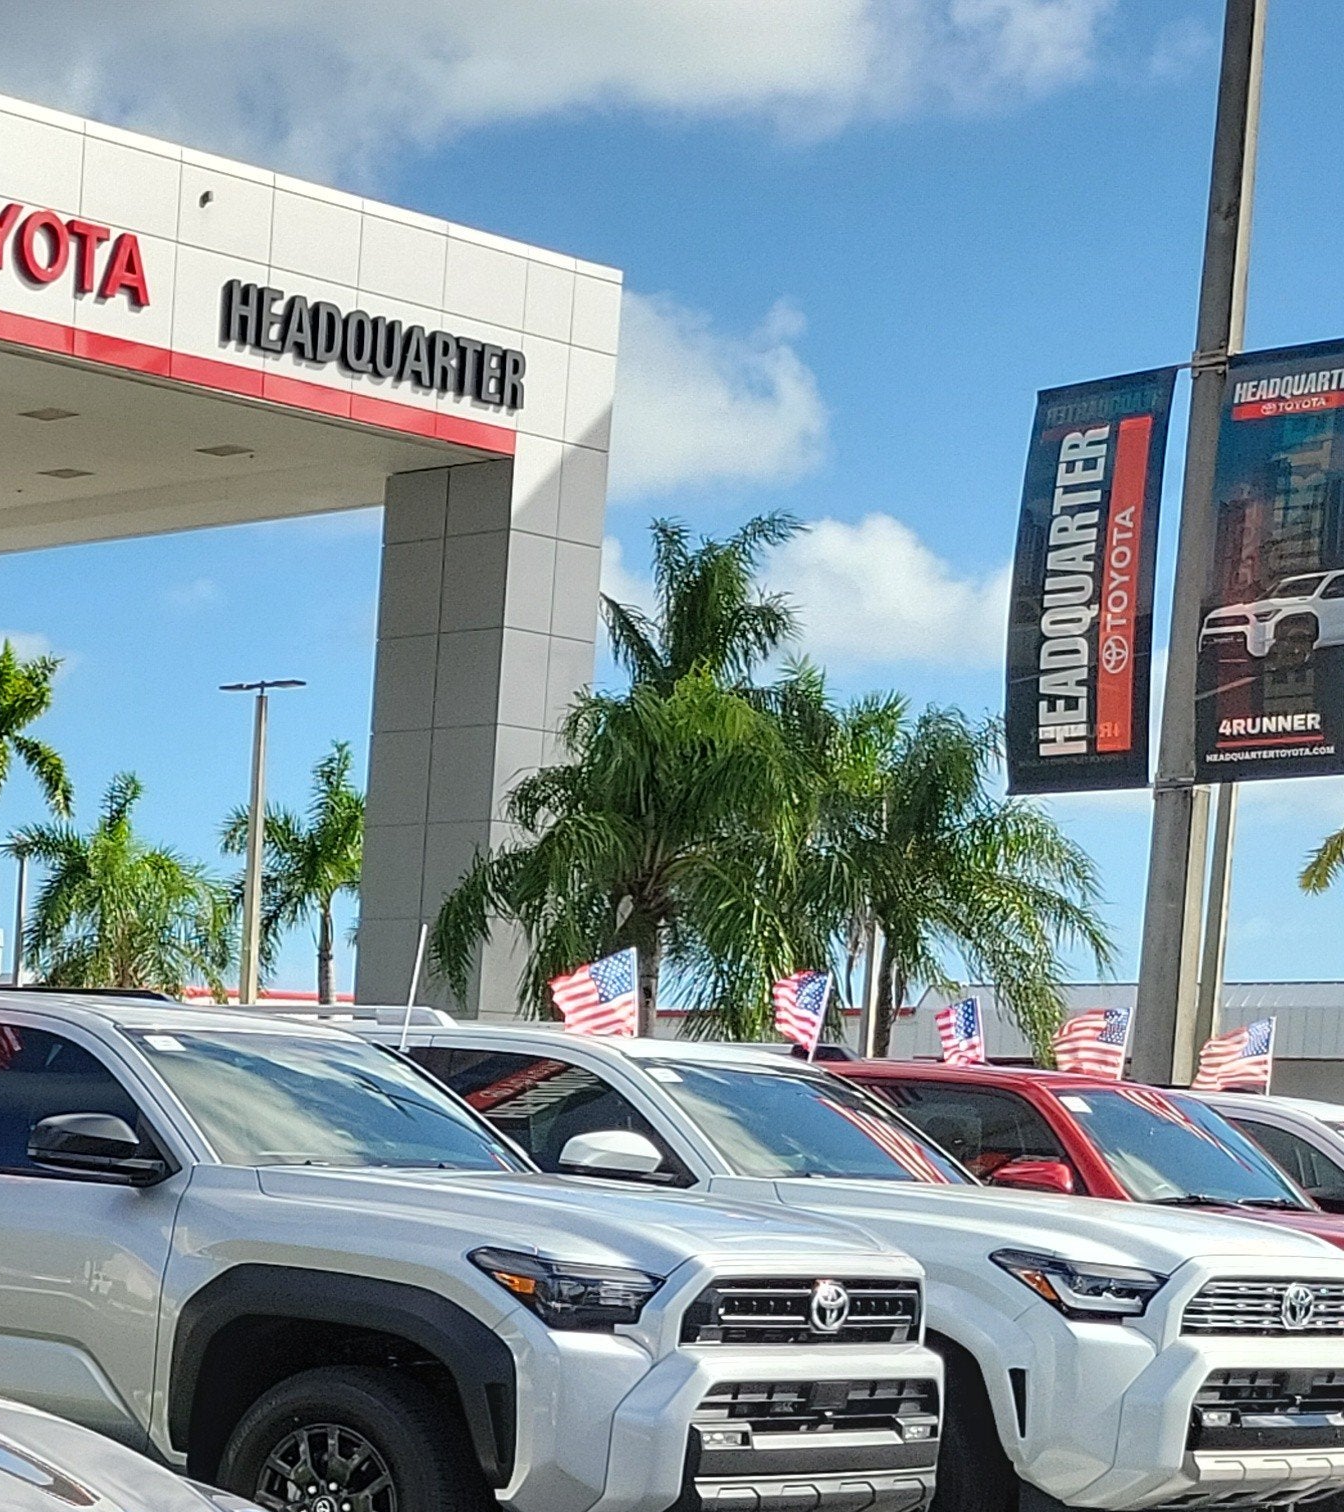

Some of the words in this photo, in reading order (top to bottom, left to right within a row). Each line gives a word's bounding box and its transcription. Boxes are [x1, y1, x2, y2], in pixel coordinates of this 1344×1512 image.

[219, 279, 527, 410] HEADQUARTER
[1278, 397, 1327, 411] TOYOTA
[1038, 425, 1110, 756] HEADQUARTER
[1105, 506, 1135, 627] TOYOTA
[1206, 745, 1335, 763] HEADQUARTERTOYOTA.COM
[1218, 713, 1321, 736] 4RUNNER
